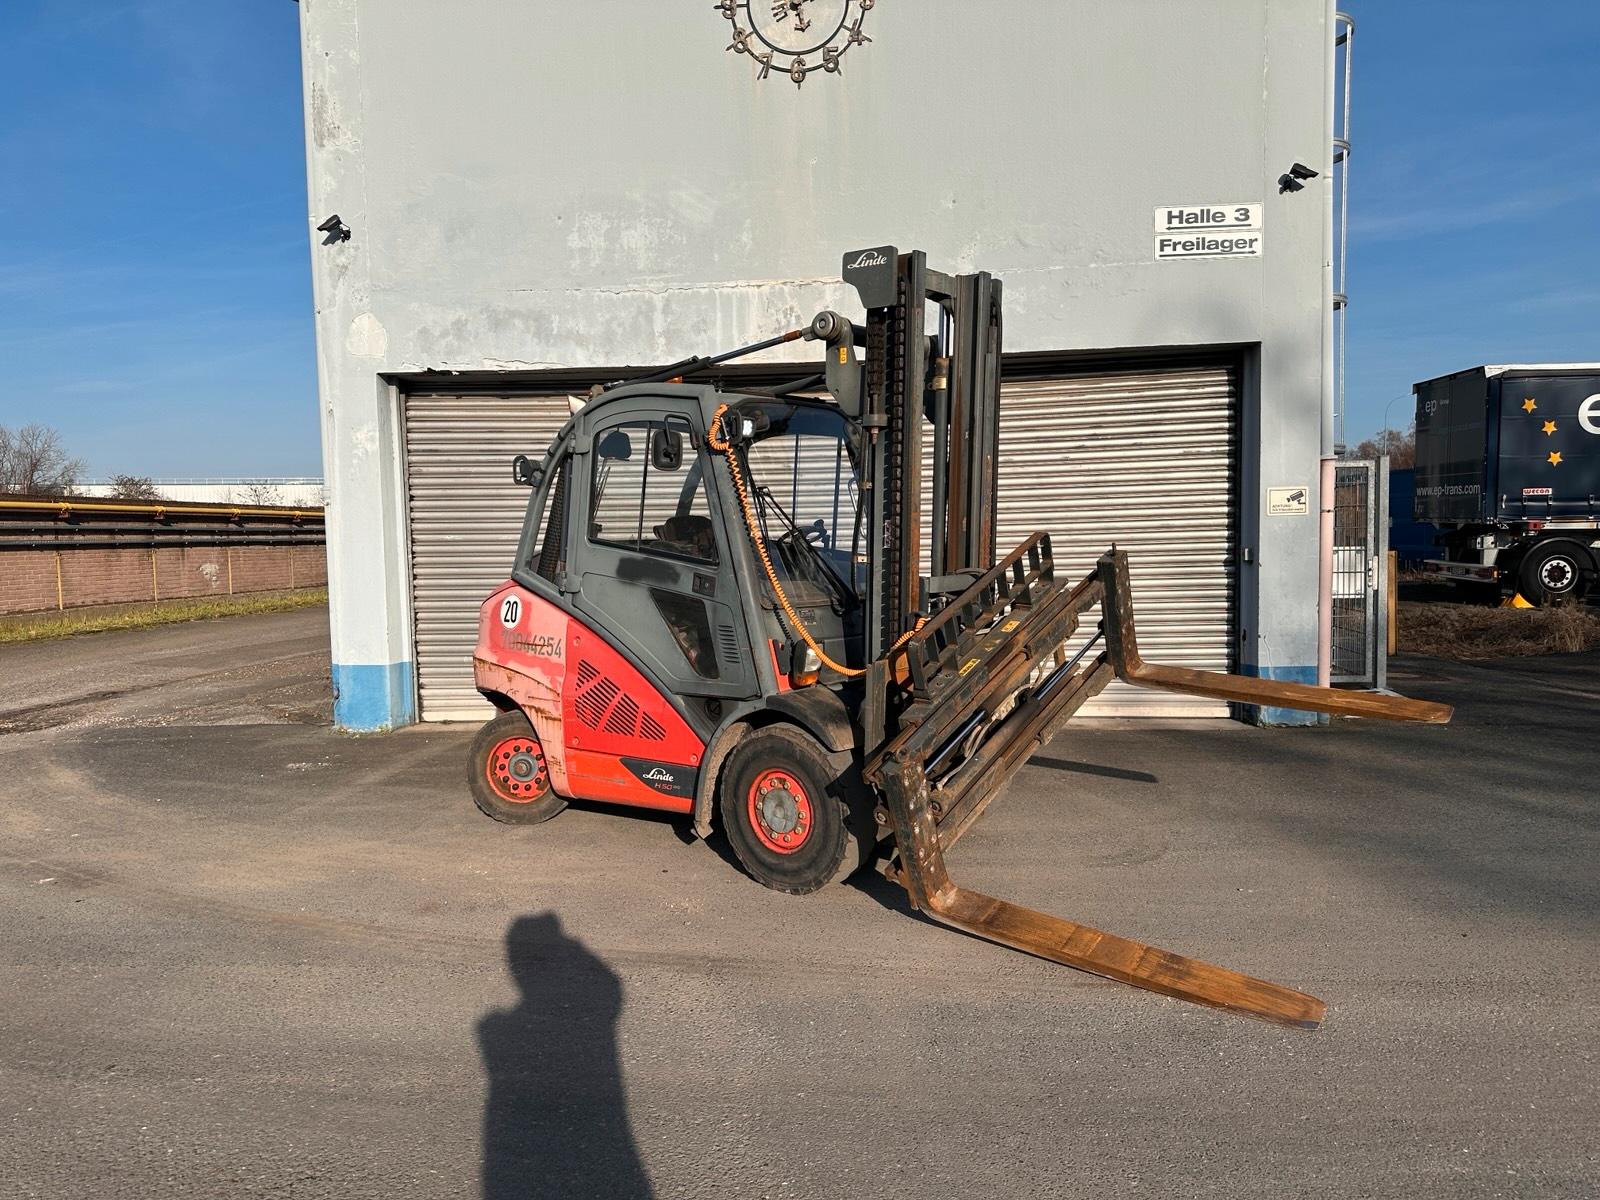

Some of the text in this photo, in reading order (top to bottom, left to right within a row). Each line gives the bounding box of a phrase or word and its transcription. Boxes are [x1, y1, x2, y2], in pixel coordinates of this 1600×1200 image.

[732, 28, 747, 54] 8
[848, 18, 866, 46] 4
[759, 52, 773, 79] 7
[790, 56, 807, 83] 6
[823, 46, 840, 73] 5
[1167, 207, 1250, 225] Halle 3
[1159, 236, 1259, 253] Freilager
[847, 250, 888, 269] Linde
[1425, 399, 1437, 416] ep
[1416, 483, 1481, 498] www.ep-trans.com
[503, 600, 519, 624] 20
[642, 767, 674, 782] Linde
